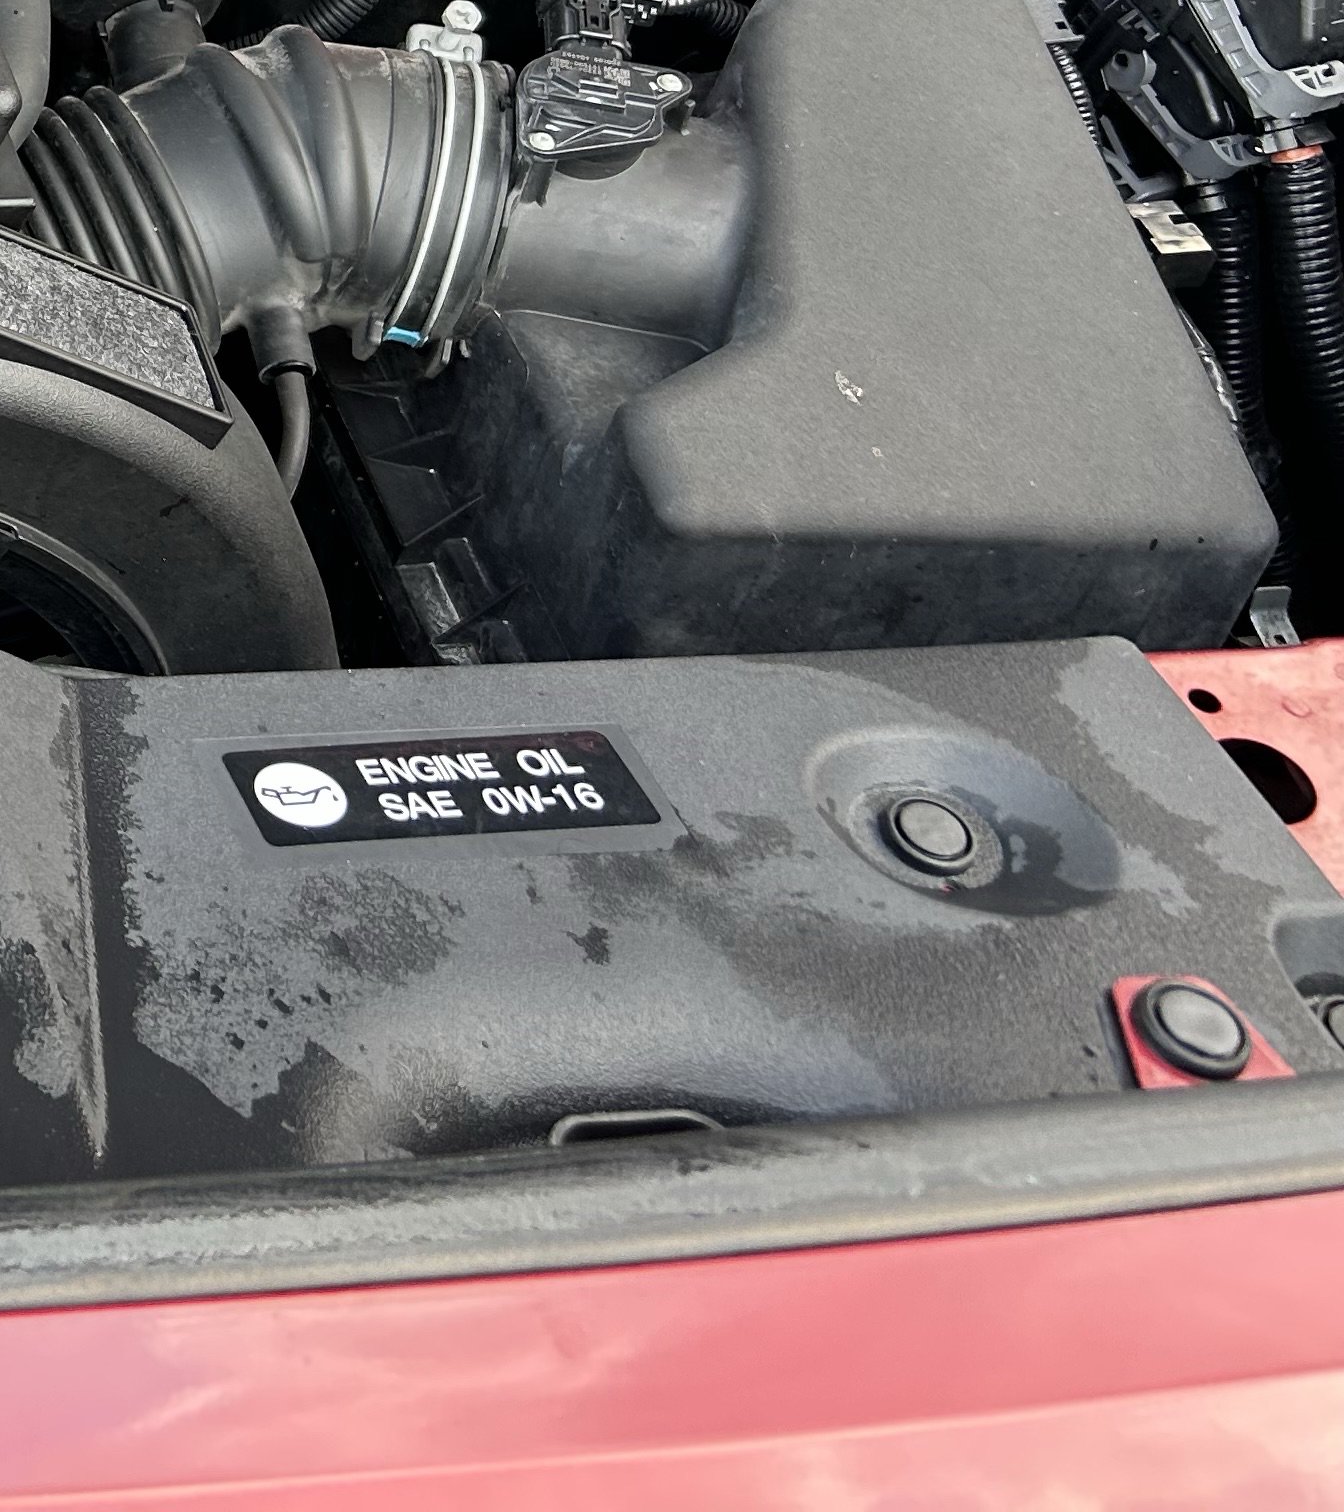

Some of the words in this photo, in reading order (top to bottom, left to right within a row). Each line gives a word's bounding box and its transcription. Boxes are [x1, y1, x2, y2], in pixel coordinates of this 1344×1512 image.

[355, 752, 502, 786] ENGINE
[516, 748, 586, 777] OIL
[378, 790, 464, 821] SAE
[481, 782, 605, 816] 0W-16
